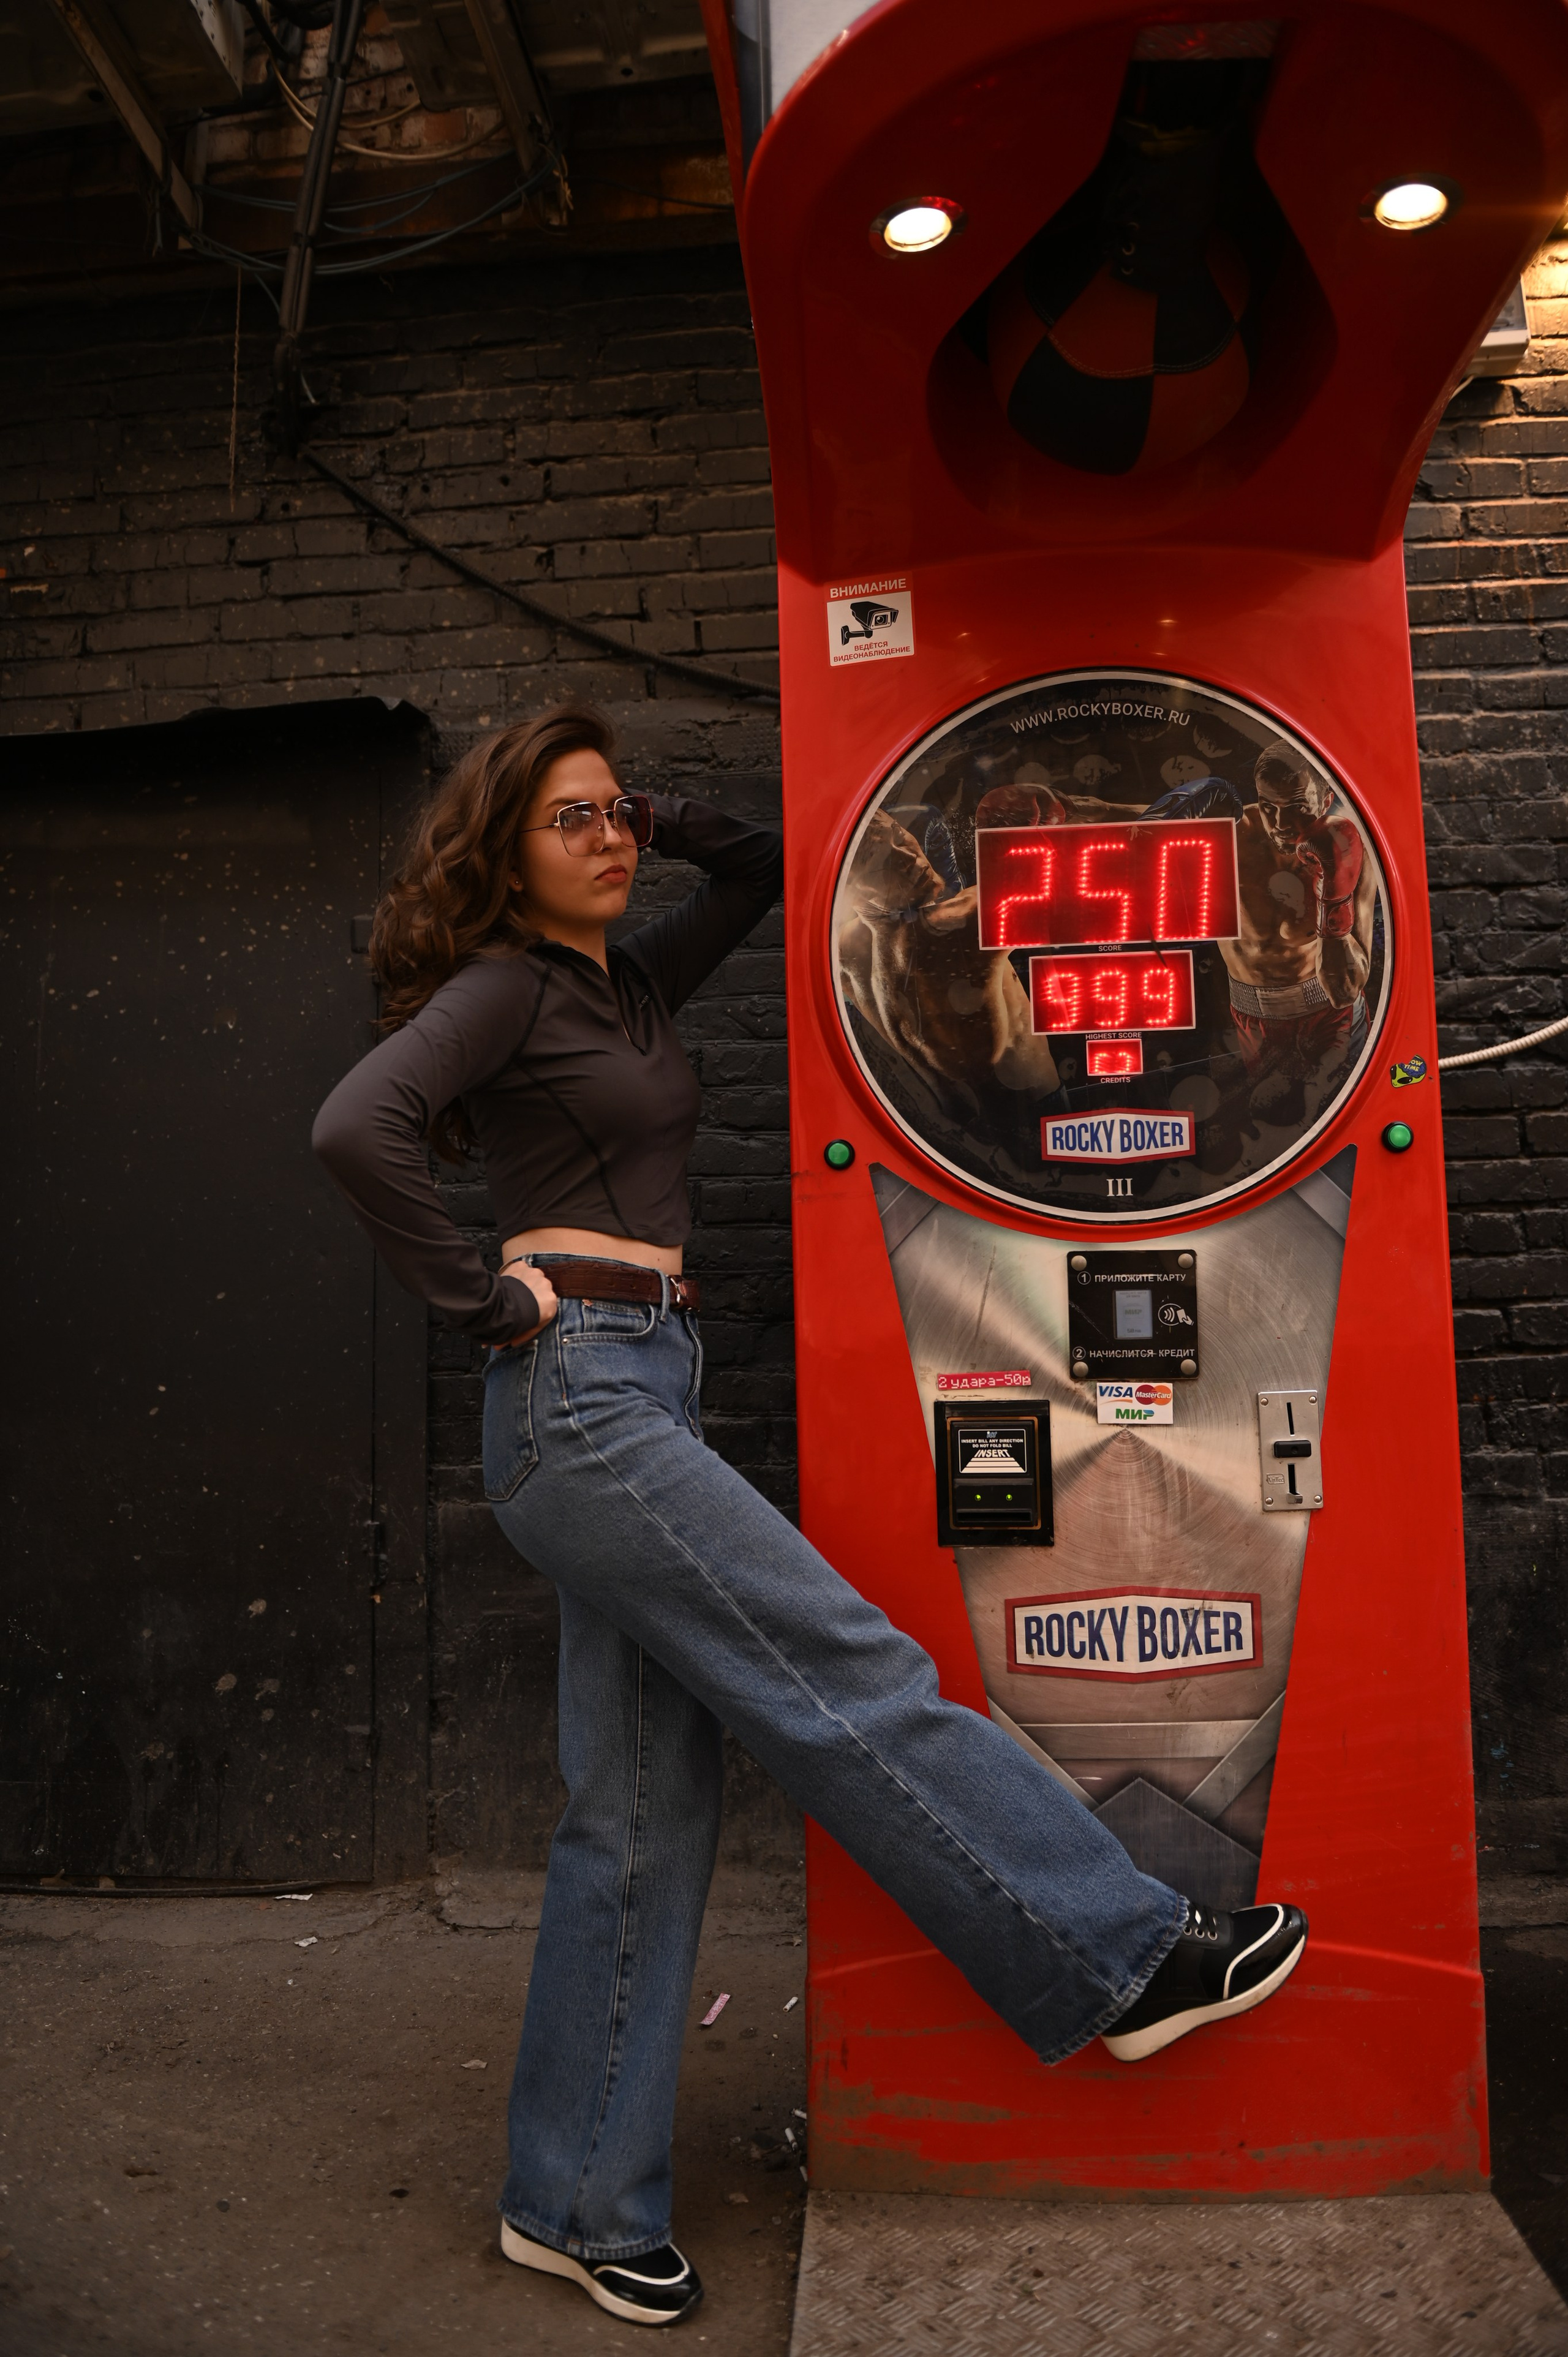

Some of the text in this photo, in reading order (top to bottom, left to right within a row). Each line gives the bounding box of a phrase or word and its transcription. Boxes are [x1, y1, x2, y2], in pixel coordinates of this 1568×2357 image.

[830, 578, 907, 598] ВНИМАНИЕ
[833, 646, 911, 662] ВИДЕОНАБЛЮДЕНИЕ
[854, 641, 888, 651] ВЕДЁТСЯ
[1010, 703, 1190, 733] WWW.ROCKYBOXER.RU
[997, 838, 1212, 946] 250
[1046, 967, 1175, 1027] 999
[1052, 1119, 1184, 1153] ROCKY BOXER
[1106, 1178, 1133, 1196] III
[1081, 1273, 1087, 1283] 1
[1076, 1349, 1195, 1358] 2 НАЧИСЛИТСЯ КРЕДИТ
[938, 1376, 947, 1388] 2
[1098, 1386, 1133, 1398] VISA
[1115, 1408, 1155, 1420] МИР
[1024, 1605, 1243, 1662] ROCKY BOXER
